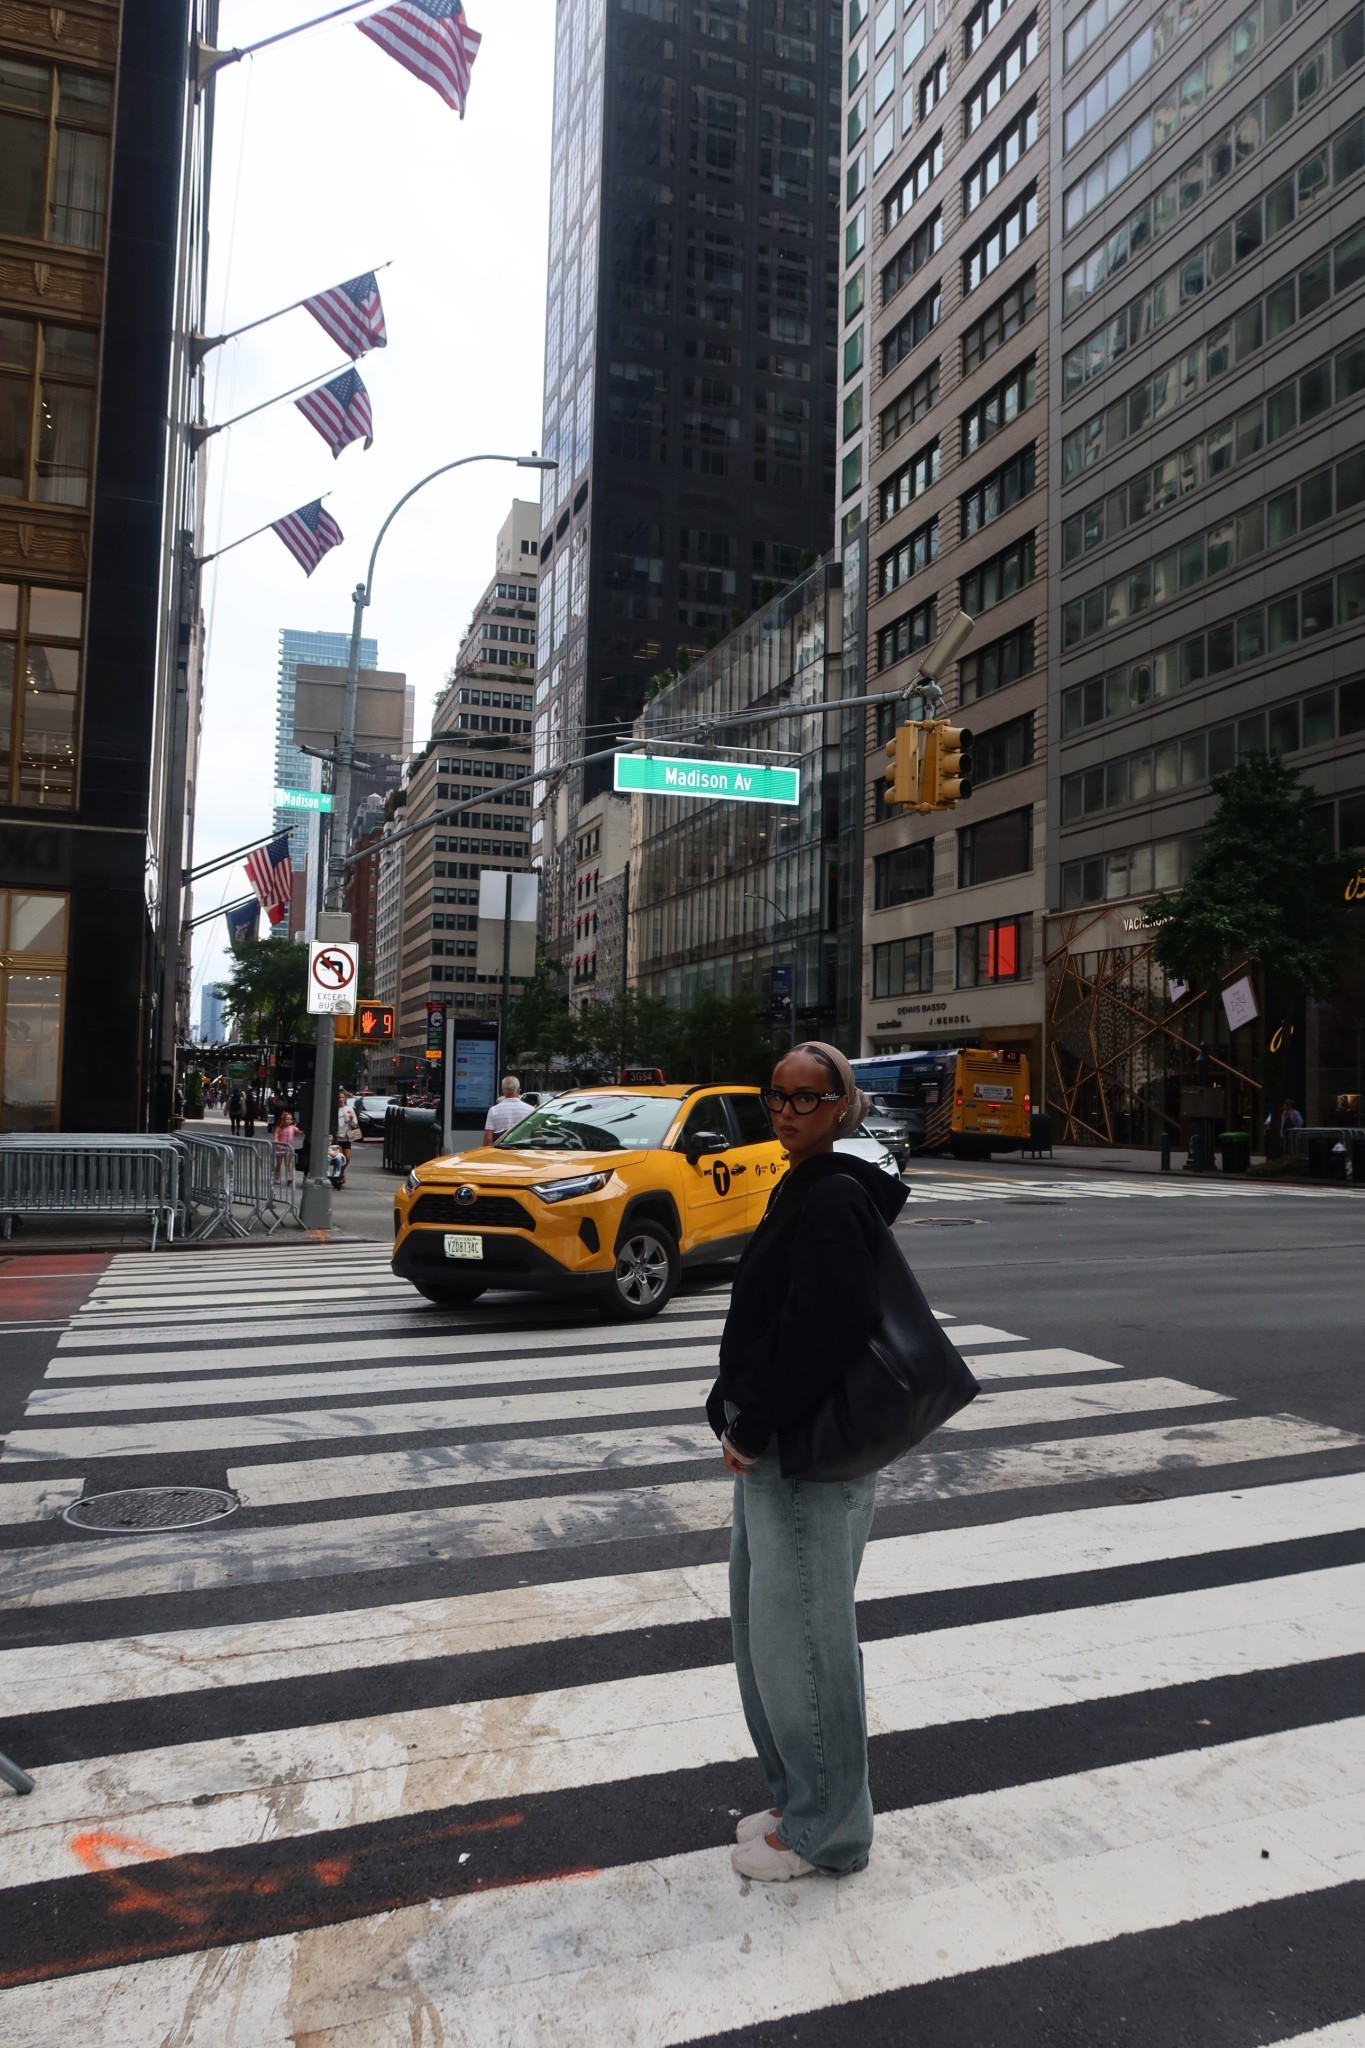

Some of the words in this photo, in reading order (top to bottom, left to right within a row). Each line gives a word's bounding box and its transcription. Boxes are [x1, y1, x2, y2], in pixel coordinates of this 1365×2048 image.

[665, 766, 728, 790] Madison
[733, 773, 753, 791] Av
[283, 791, 319, 809] Madison
[321, 795, 331, 804] Av
[317, 992, 347, 1001] EXCEPT
[897, 1005, 920, 1015] DENNIS
[922, 1003, 947, 1013] BASSO
[383, 1014, 392, 1034] 9
[630, 1071, 652, 1081] 3G54
